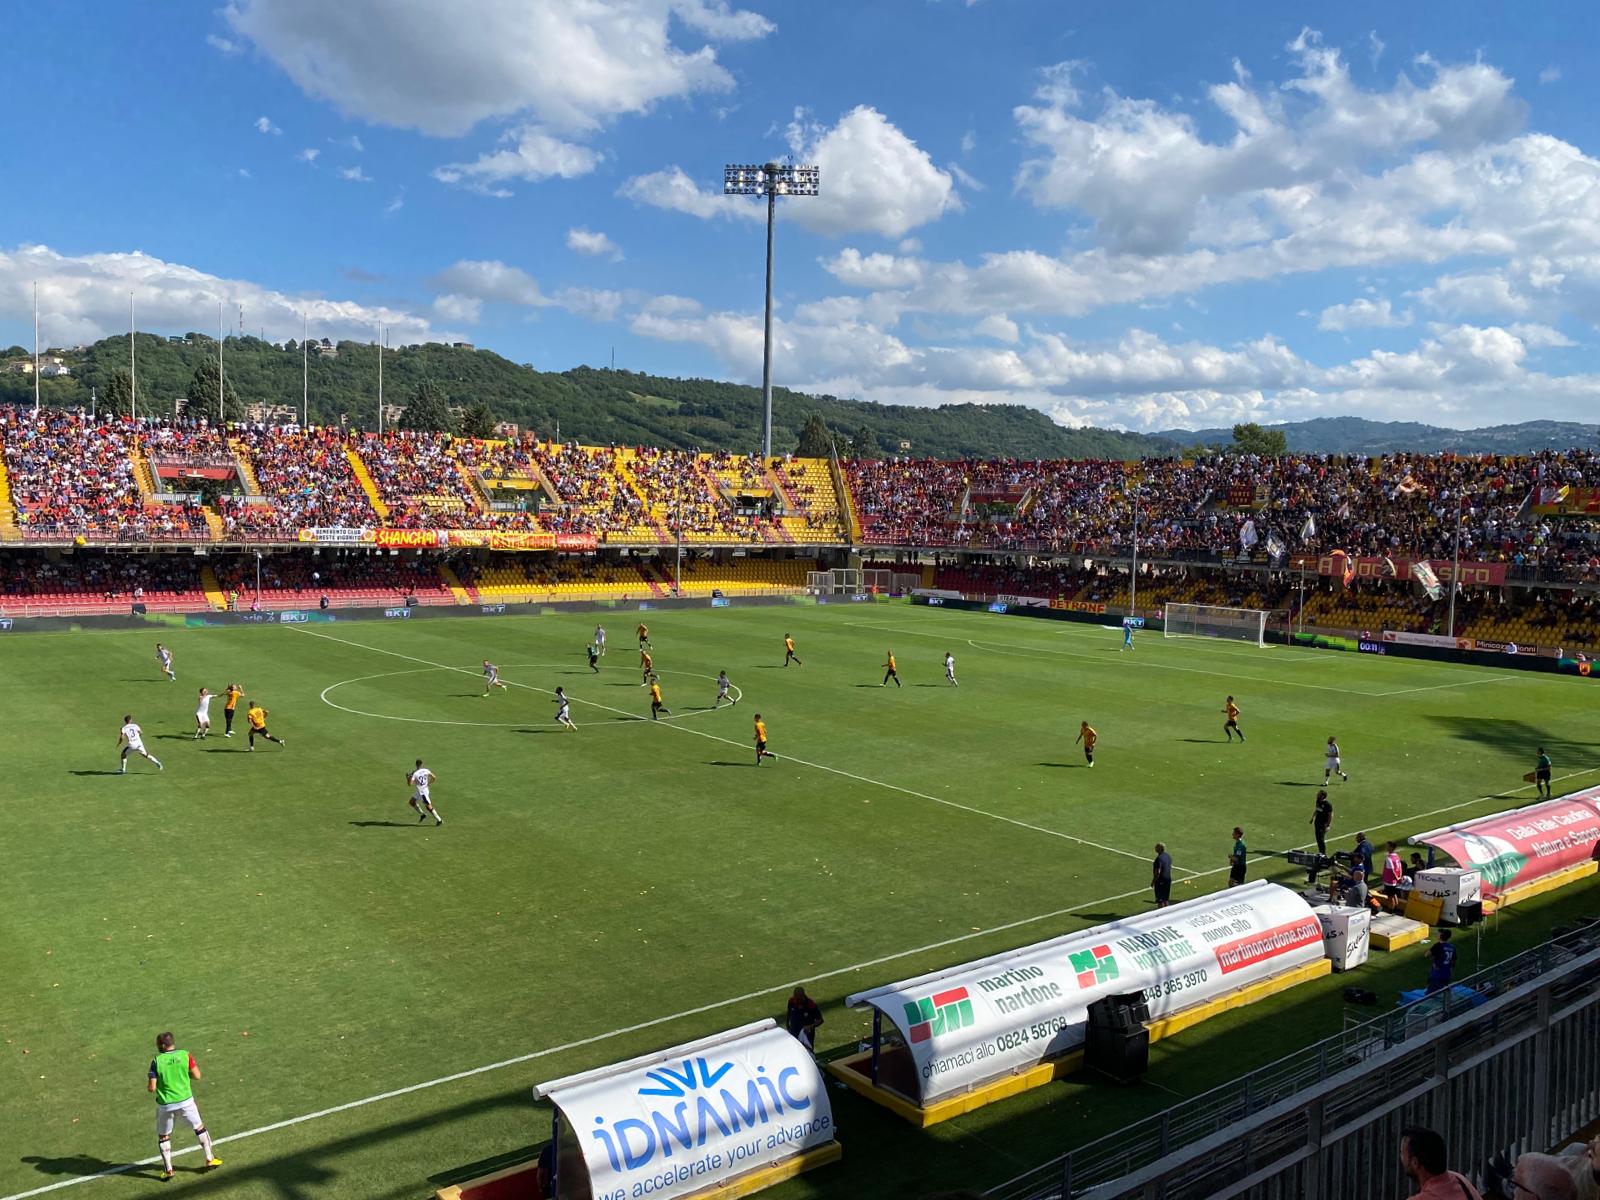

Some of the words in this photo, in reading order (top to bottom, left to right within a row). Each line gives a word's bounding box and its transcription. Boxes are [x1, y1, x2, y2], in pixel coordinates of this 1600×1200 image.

[379, 530, 436, 545] SHANGHAI
[281, 613, 306, 621] BKT
[1360, 642, 1378, 652] 00:11
[129, 728, 136, 738] 3
[1505, 825, 1539, 840] Dalla
[1529, 818, 1559, 833] Valle
[1531, 838, 1564, 858] Natura
[1186, 912, 1216, 928] visita
[1221, 903, 1254, 918] nostro
[1116, 925, 1185, 954] NARDONE
[1201, 924, 1234, 942] nuovo
[1231, 919, 1252, 933] sito
[1132, 939, 1197, 971] HOTELLERIE
[1220, 922, 1319, 967] martinonardone.com
[976, 965, 1044, 993] martino
[1163, 977, 1183, 995] 365
[1183, 968, 1208, 989] 3970
[995, 981, 1063, 1014] nardone
[922, 1051, 974, 1079] chiamaci
[976, 1042, 996, 1060] allo
[996, 1031, 1029, 1052] 0824
[1030, 1016, 1068, 1040] 58768
[632, 1154, 722, 1196] accelerate
[726, 1139, 761, 1169] your
[767, 1114, 830, 1149] advance
